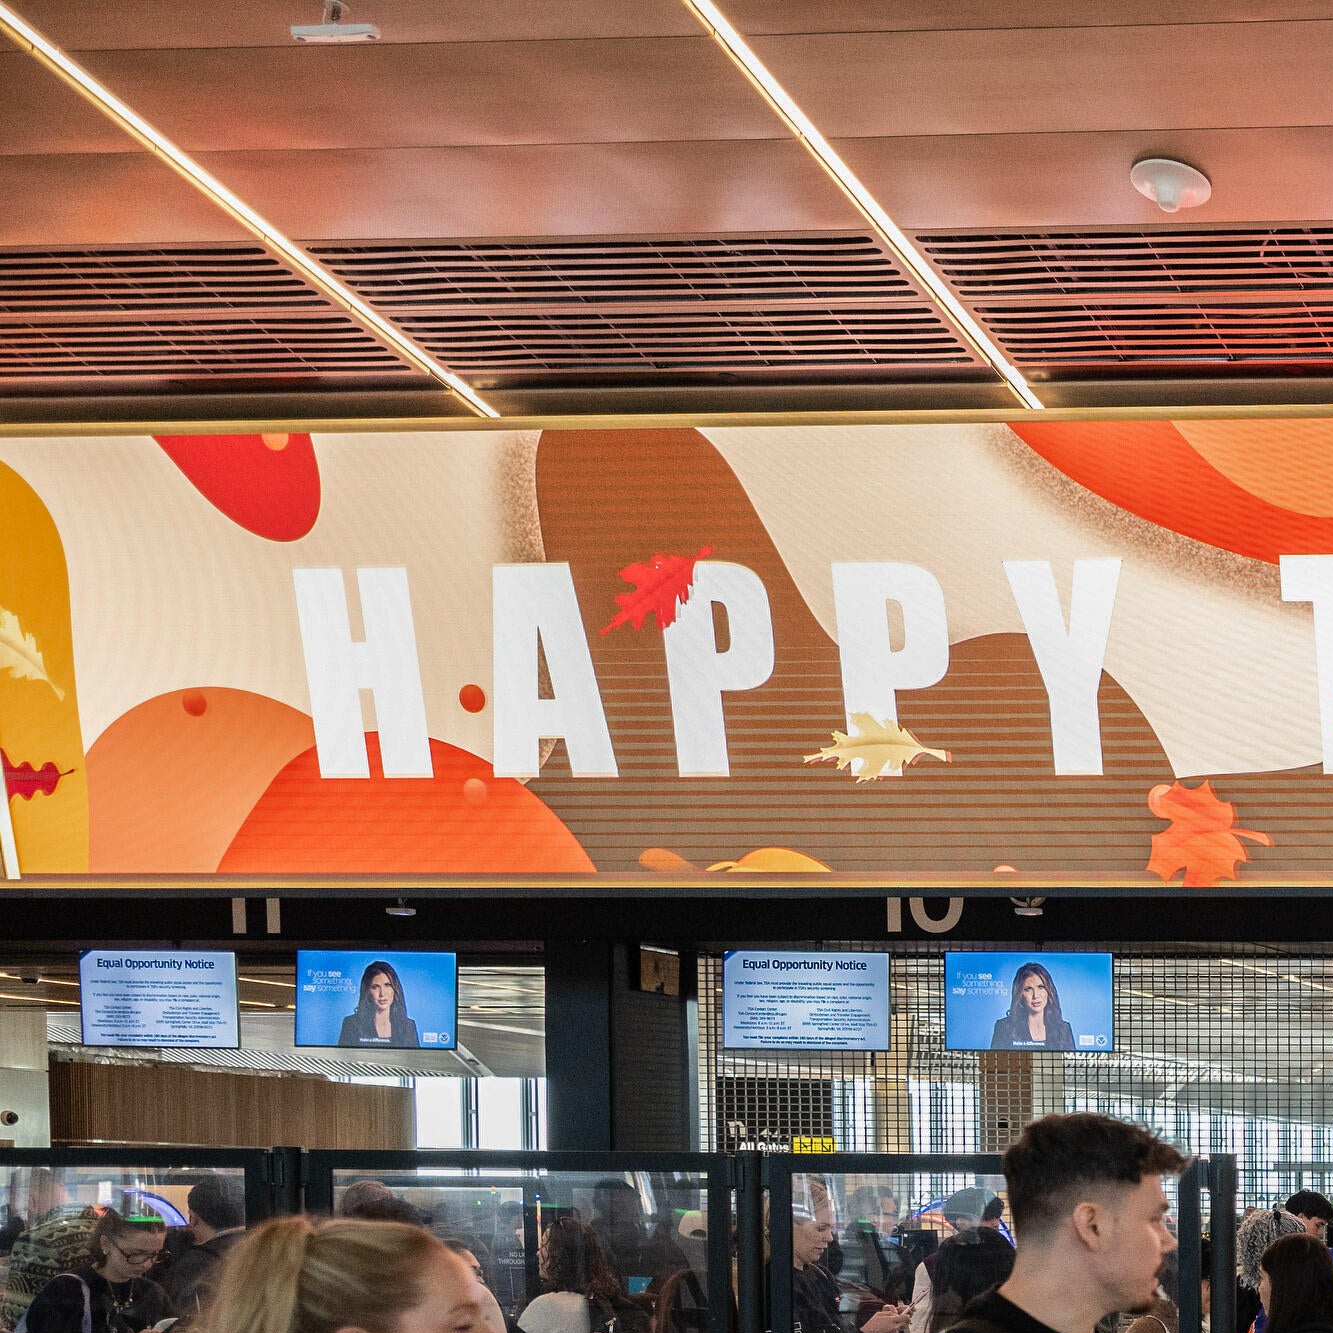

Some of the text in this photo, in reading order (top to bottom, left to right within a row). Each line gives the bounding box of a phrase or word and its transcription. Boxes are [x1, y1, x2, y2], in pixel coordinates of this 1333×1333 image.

[293, 558, 1123, 779] HAPPY
[97, 958, 214, 970] Equal Opportunity Notice
[742, 959, 867, 972] Equal Opportunity Notice
[313, 971, 327, 979] you
[304, 984, 356, 993] say something
[952, 987, 1008, 996] say something
[740, 1142, 790, 1152] All Gates
